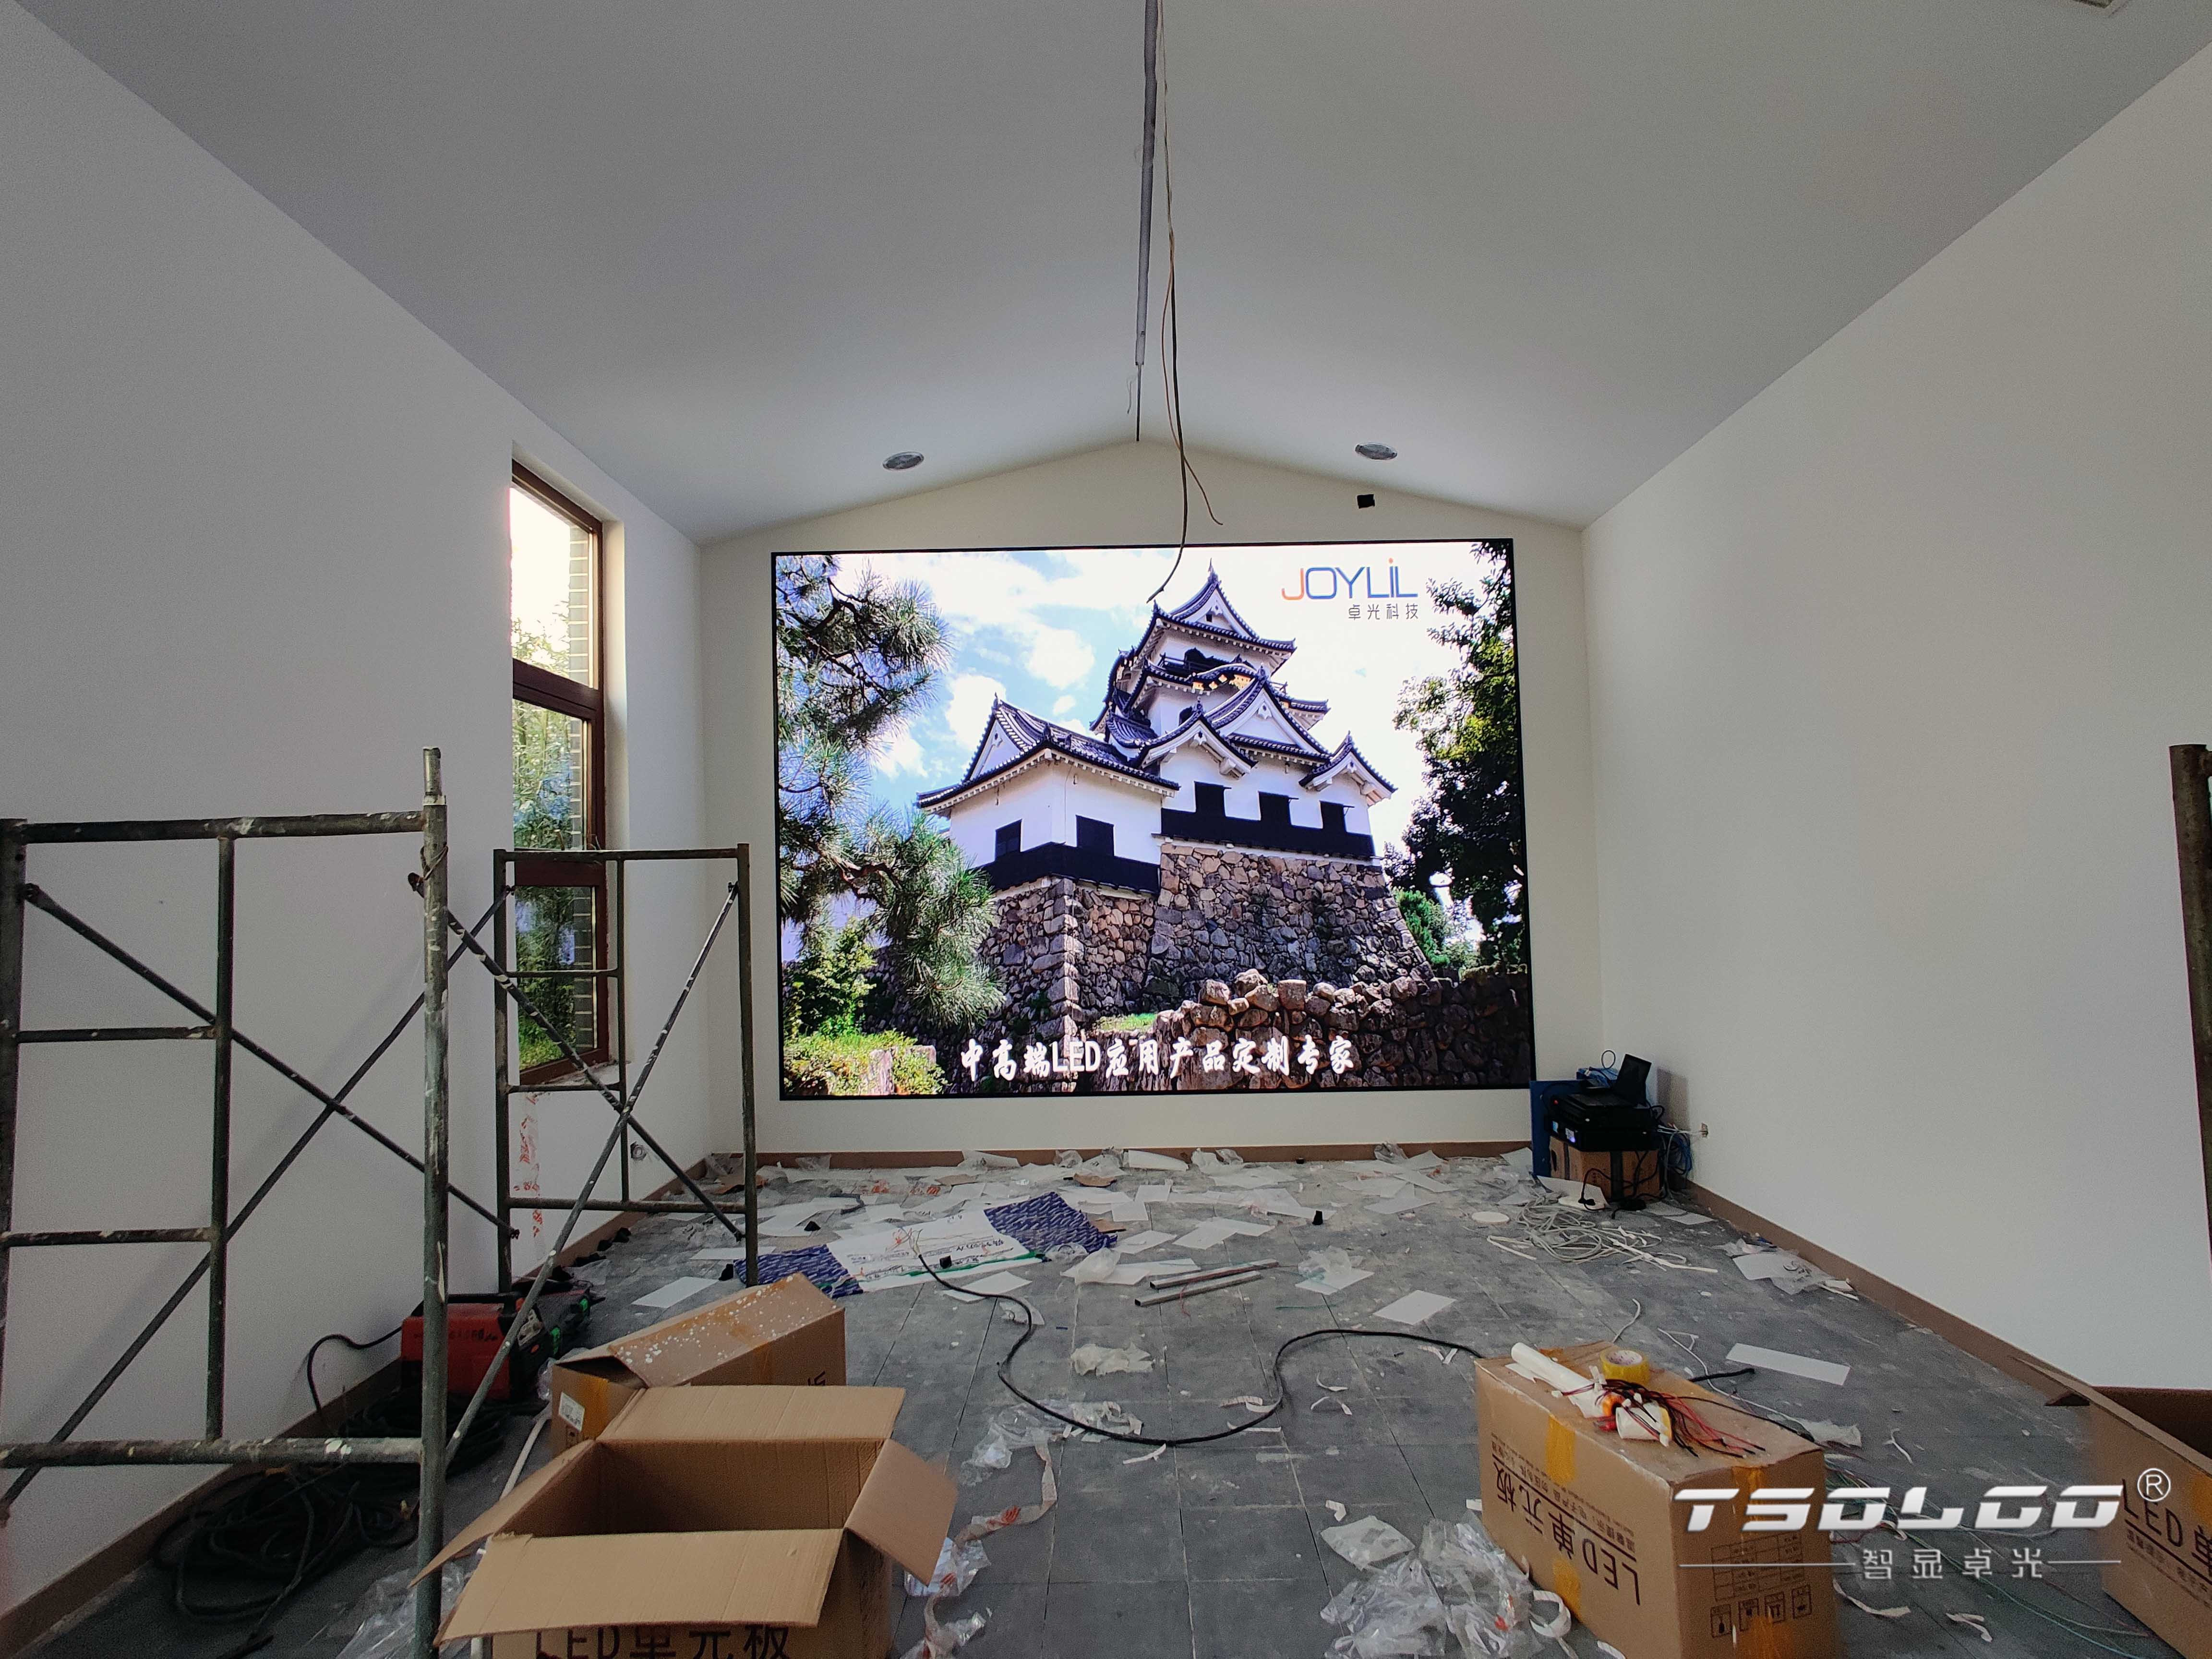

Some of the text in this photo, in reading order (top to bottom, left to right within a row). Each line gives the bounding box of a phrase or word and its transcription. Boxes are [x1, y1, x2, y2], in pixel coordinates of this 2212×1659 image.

[1348, 602, 1419, 620] 卓光科技
[961, 1034, 1355, 1082] 中高端LED应用产品定制专家
